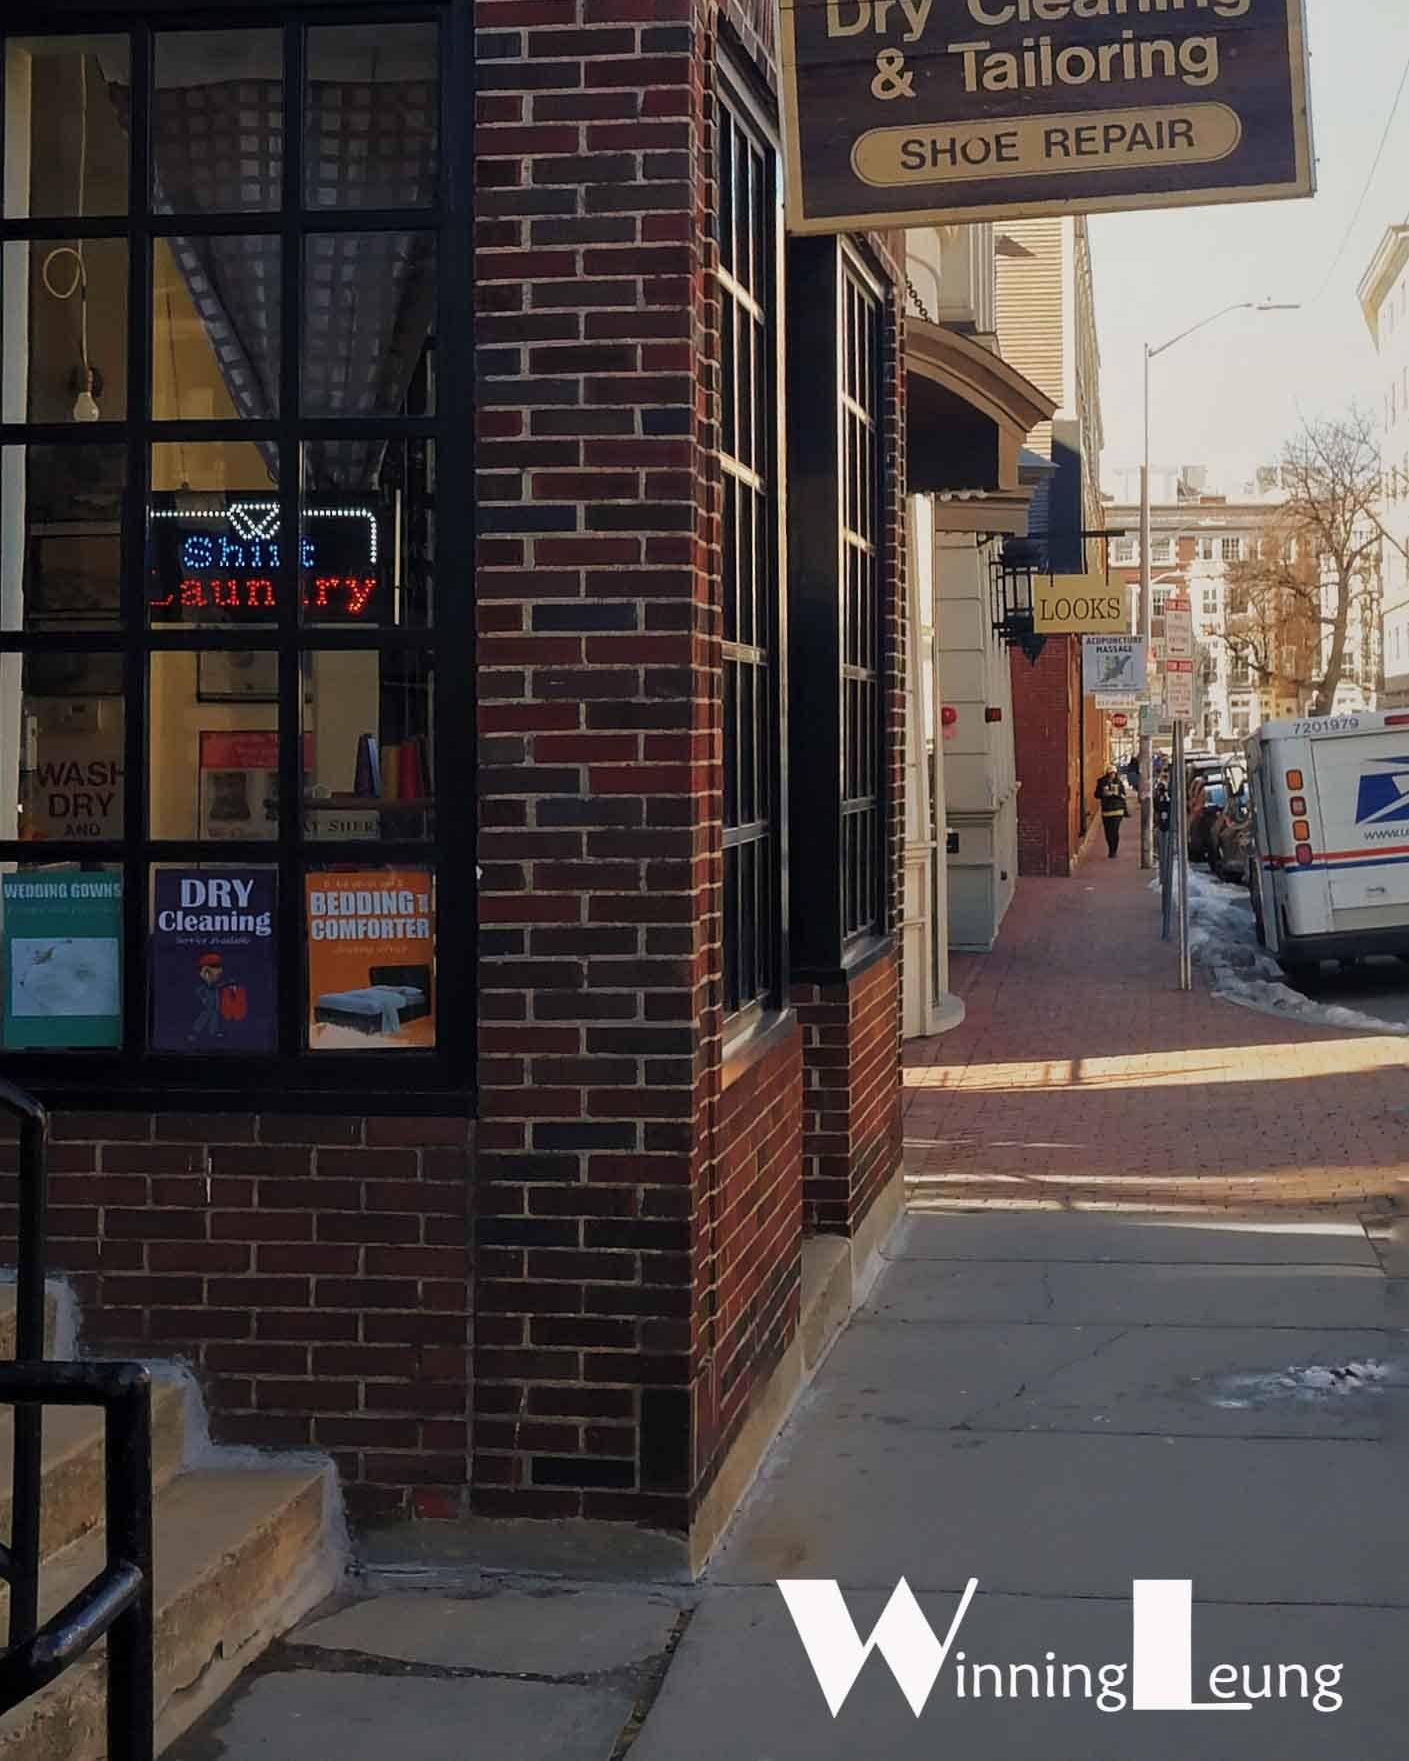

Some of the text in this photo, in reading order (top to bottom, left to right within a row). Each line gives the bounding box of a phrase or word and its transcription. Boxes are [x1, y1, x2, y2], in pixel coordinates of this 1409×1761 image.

[870, 29, 1220, 101] & Tailoring
[900, 119, 1196, 170] SHOE REPAIR
[1039, 595, 1121, 622] LOOKS
[1086, 636, 1143, 645] ACUPUNCTURE
[1096, 646, 1133, 654] MASSAGE
[1292, 717, 1360, 735] 7201979
[48, 792, 116, 818] DRY
[64, 822, 102, 837] AND
[3, 882, 122, 900] WEDDING GOWNS
[179, 878, 254, 908] DRY
[309, 891, 414, 917] BEDDING
[158, 909, 273, 937] Cleaning
[311, 917, 431, 941] COMFORTER
